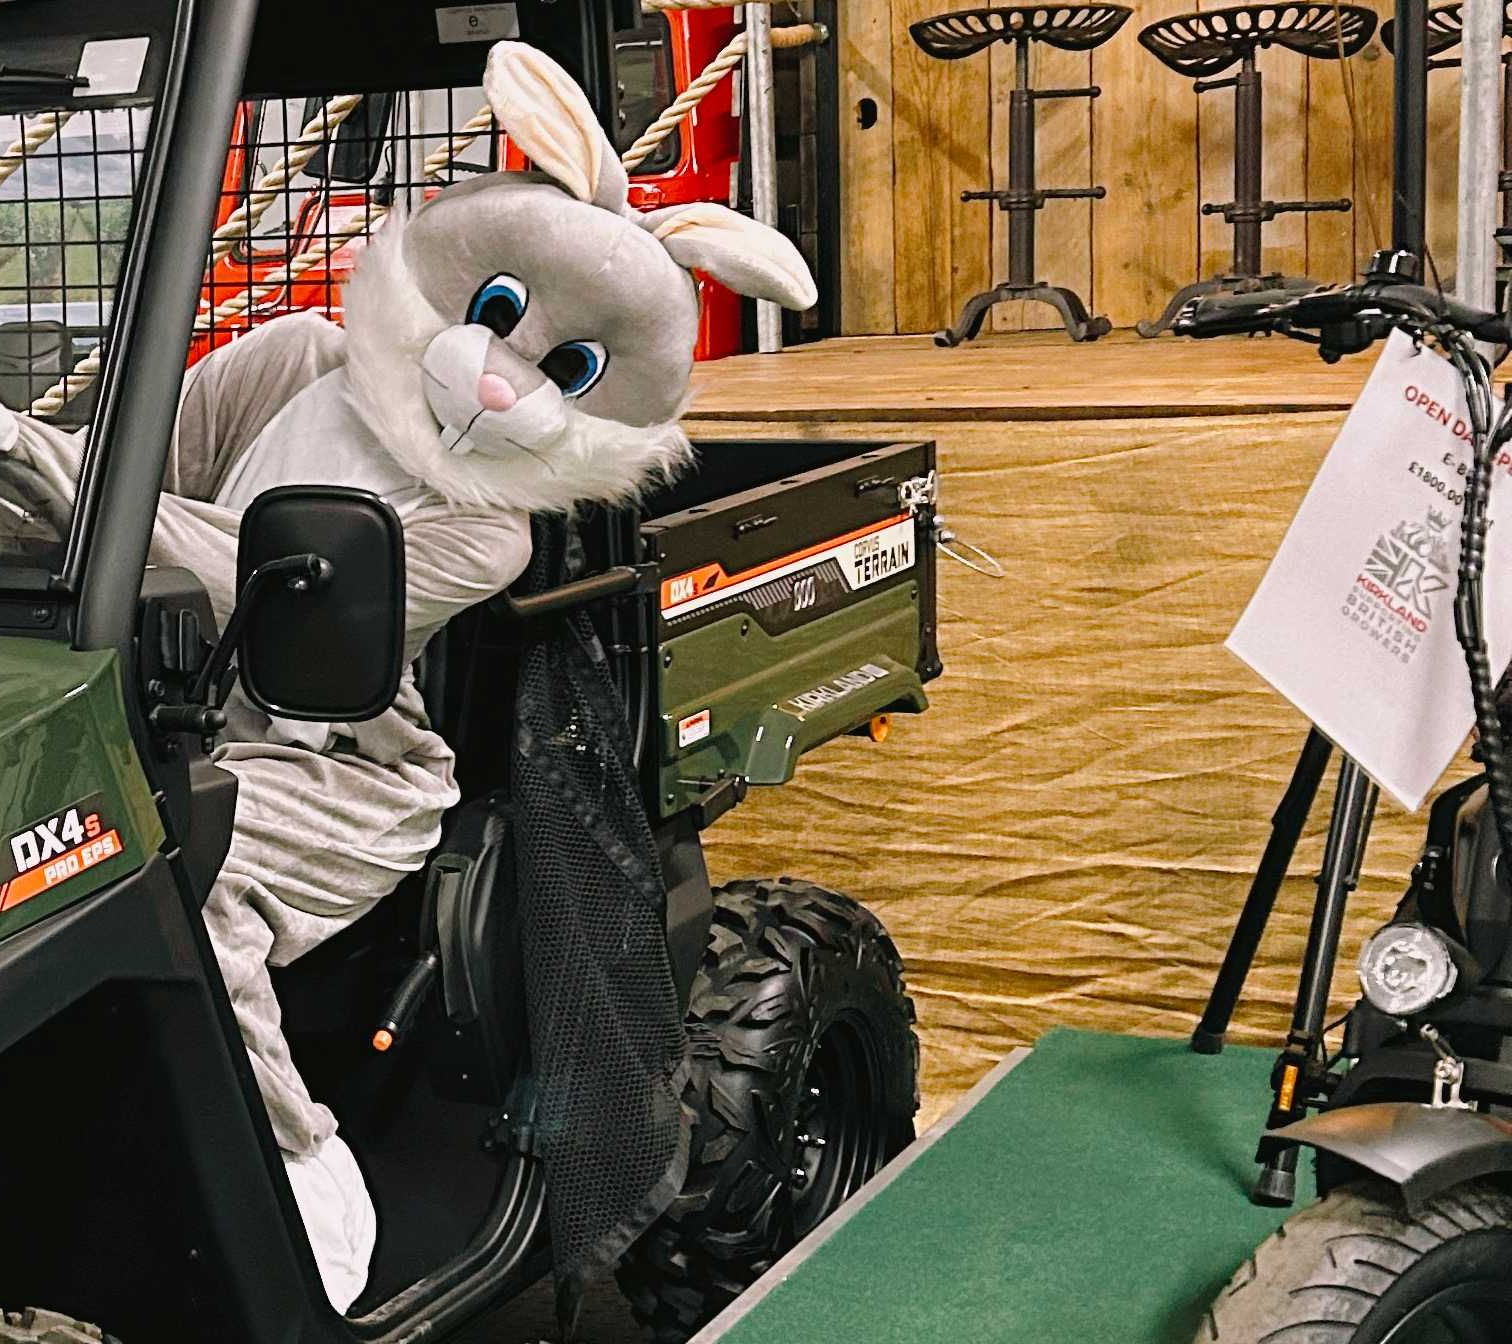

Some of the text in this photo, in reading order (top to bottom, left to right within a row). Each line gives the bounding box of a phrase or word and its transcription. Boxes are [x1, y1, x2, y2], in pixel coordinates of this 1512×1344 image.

[1404, 385, 1475, 447] OPEN DA
[854, 541, 909, 584] TERRAIN
[1356, 574, 1428, 633] KIRKLAND
[43, 835, 115, 885] PRO EPS
